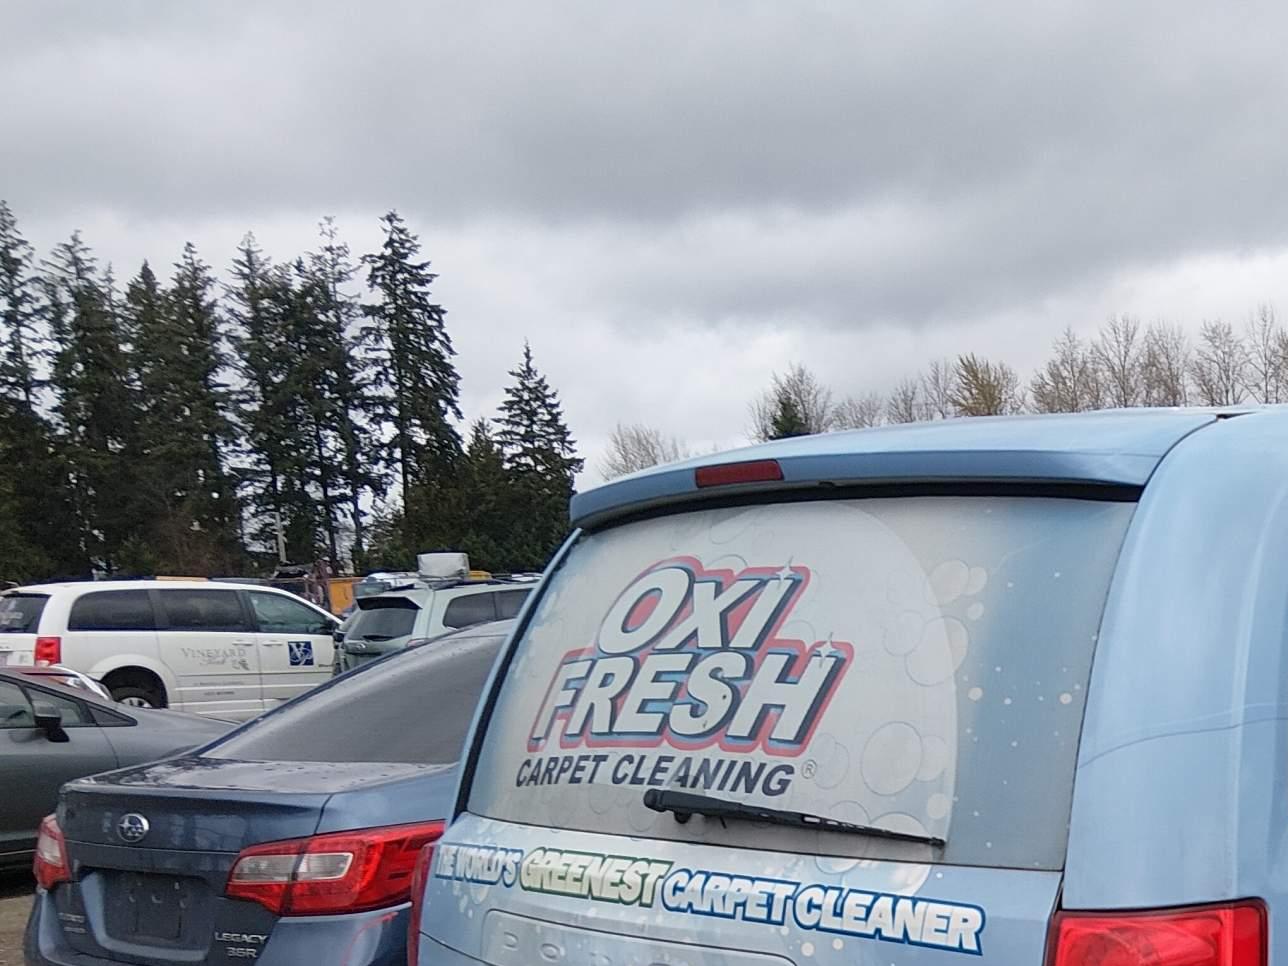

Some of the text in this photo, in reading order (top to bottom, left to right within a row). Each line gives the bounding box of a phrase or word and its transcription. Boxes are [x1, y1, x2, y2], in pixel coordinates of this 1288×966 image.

[596, 559, 807, 655] OXI
[529, 646, 852, 752] FRESH
[515, 754, 797, 796] CARPET CLEANING
[214, 931, 268, 944] LEGACY
[454, 844, 524, 888] WORLD'S
[519, 847, 674, 908] GREENEST
[661, 868, 801, 929] CARPET
[793, 882, 986, 956] CLEANER
